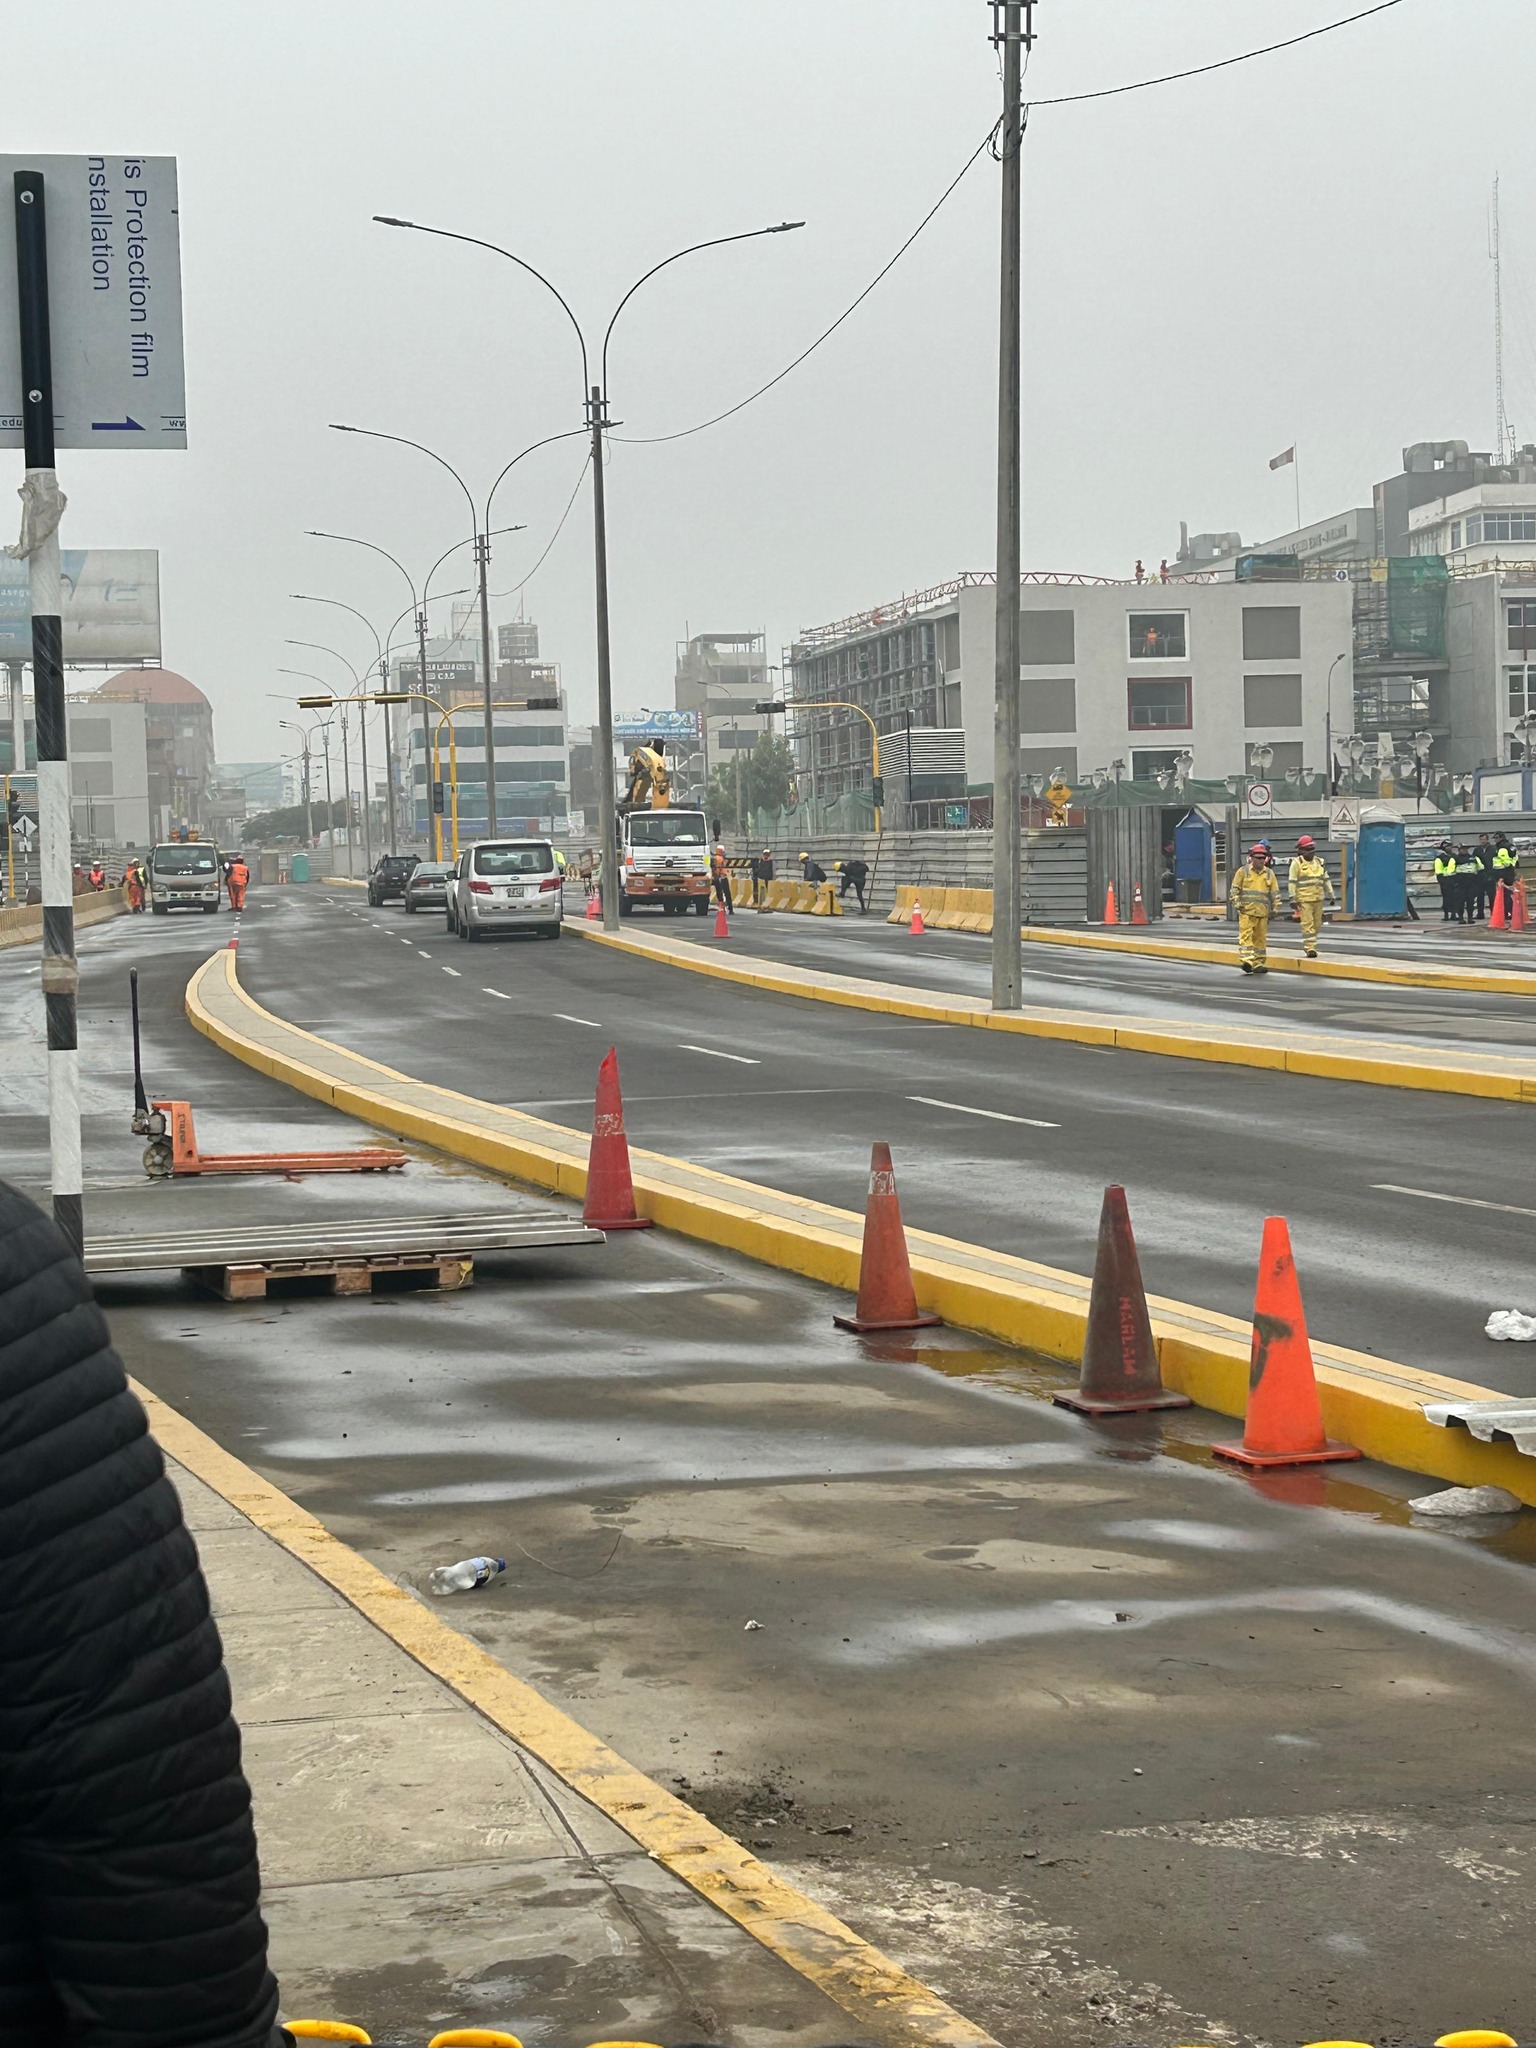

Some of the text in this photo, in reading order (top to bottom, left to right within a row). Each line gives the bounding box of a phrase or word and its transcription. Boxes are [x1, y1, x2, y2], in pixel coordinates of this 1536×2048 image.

[88, 157, 115, 290] nstallation
[124, 159, 154, 377] is Protection film
